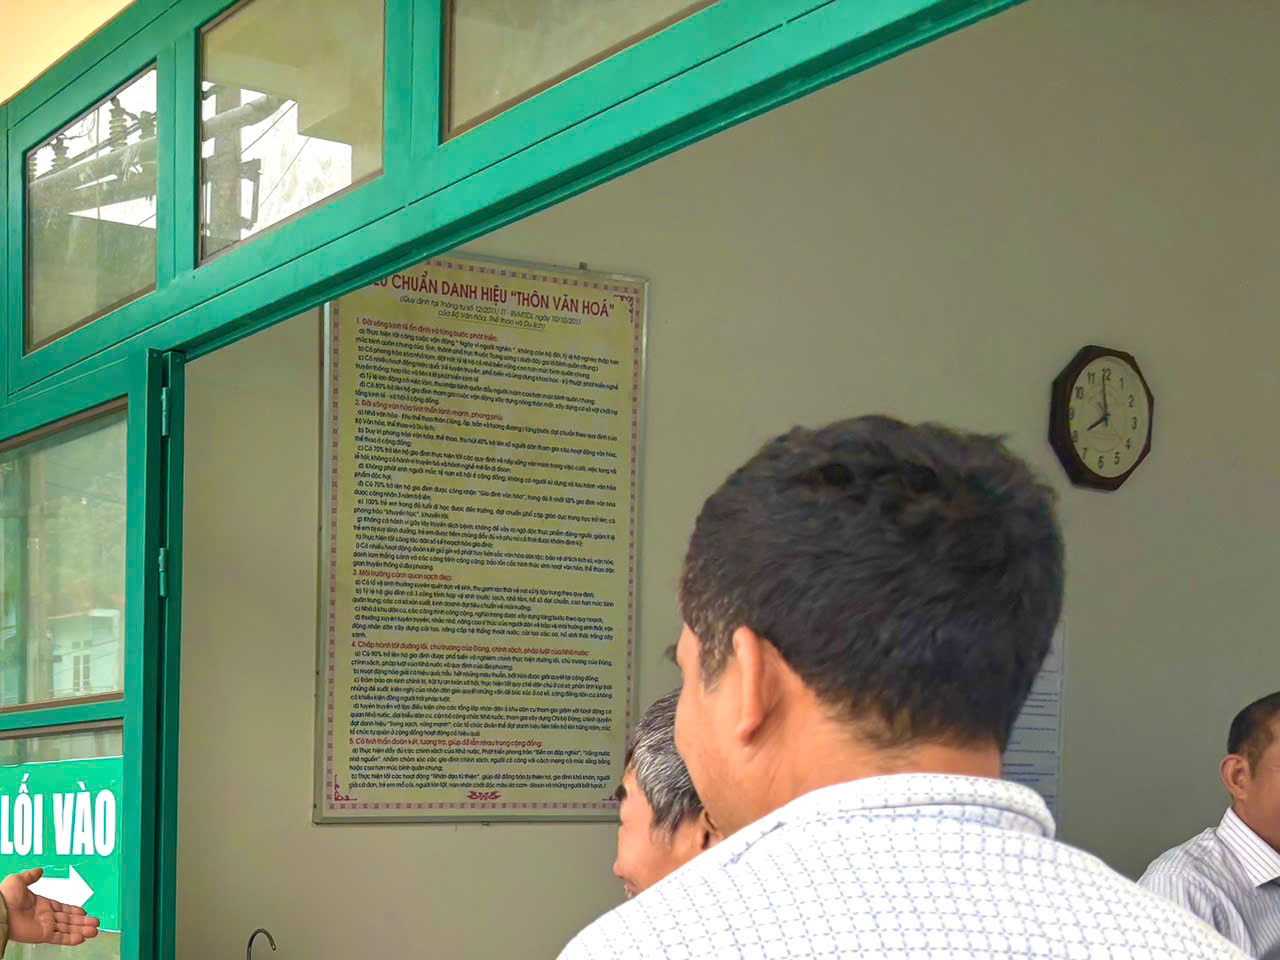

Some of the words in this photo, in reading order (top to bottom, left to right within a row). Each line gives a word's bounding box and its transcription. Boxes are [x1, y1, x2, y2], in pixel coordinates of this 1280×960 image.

[391, 270, 437, 294] CHUẨN
[441, 280, 477, 299] DANH
[480, 283, 508, 306] HIỆU
[552, 294, 578, 313] VĂN
[1087, 371, 1095, 384] 11
[1102, 367, 1112, 381] 12
[1120, 377, 1124, 390] 1
[1075, 386, 1084, 400] 10
[1128, 394, 1134, 408] 2
[1132, 416, 1137, 430] 3
[1082, 447, 1088, 460] 7
[1114, 451, 1120, 465] 5
[1098, 455, 1104, 469] 6
[0, 772, 44, 856] LỐI
[53, 781, 116, 857] VÀO
